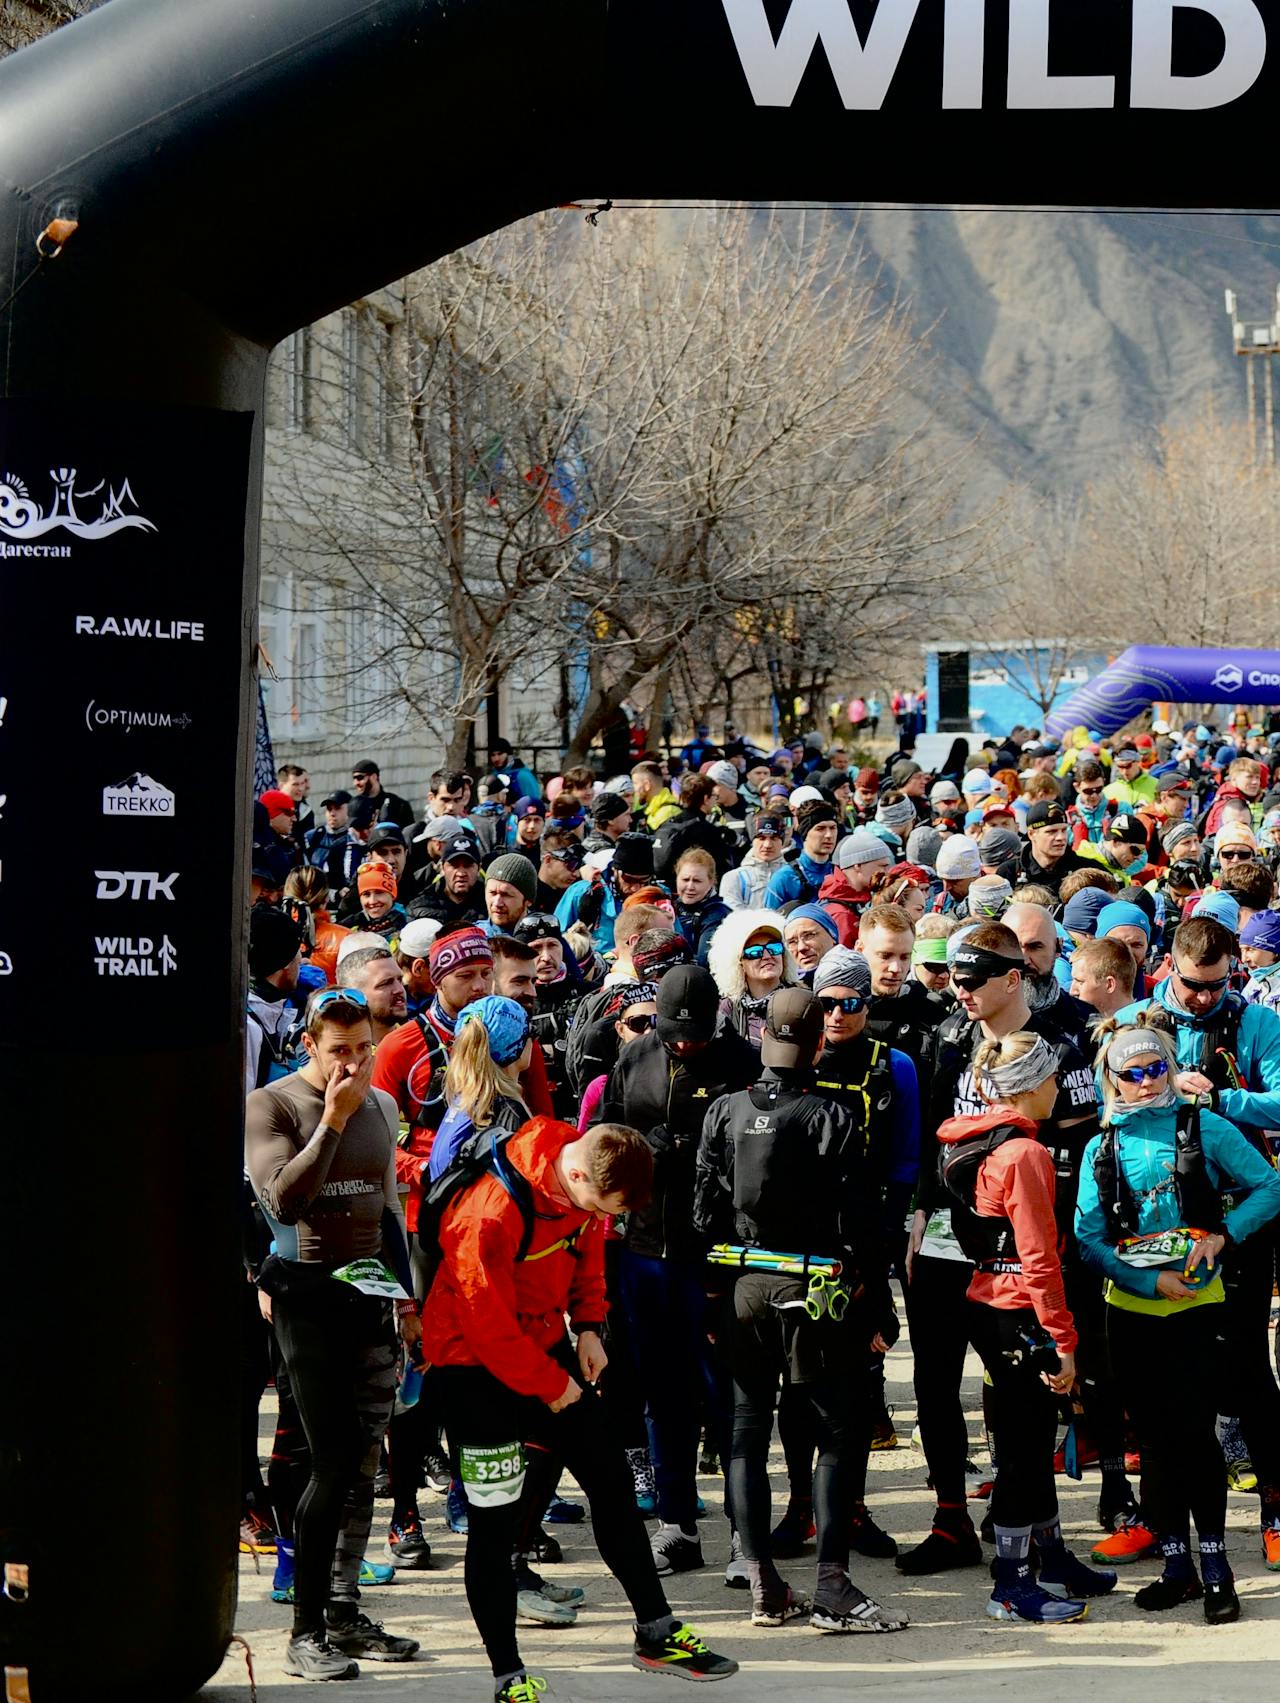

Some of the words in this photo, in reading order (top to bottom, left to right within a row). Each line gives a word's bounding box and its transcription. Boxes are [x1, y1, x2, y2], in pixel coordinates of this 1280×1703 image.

[721, 0, 1267, 111] WILD
[108, 796, 170, 812] TREKKO
[94, 869, 180, 901] DTK
[94, 936, 154, 956] WILD
[94, 957, 160, 977] TRAIL
[626, 984, 650, 998] WILD
[1123, 1041, 1160, 1058] TERREX
[462, 1447, 498, 1457] DAGESTAN
[498, 1444, 516, 1455] WILD
[475, 1455, 521, 1480] 3298
